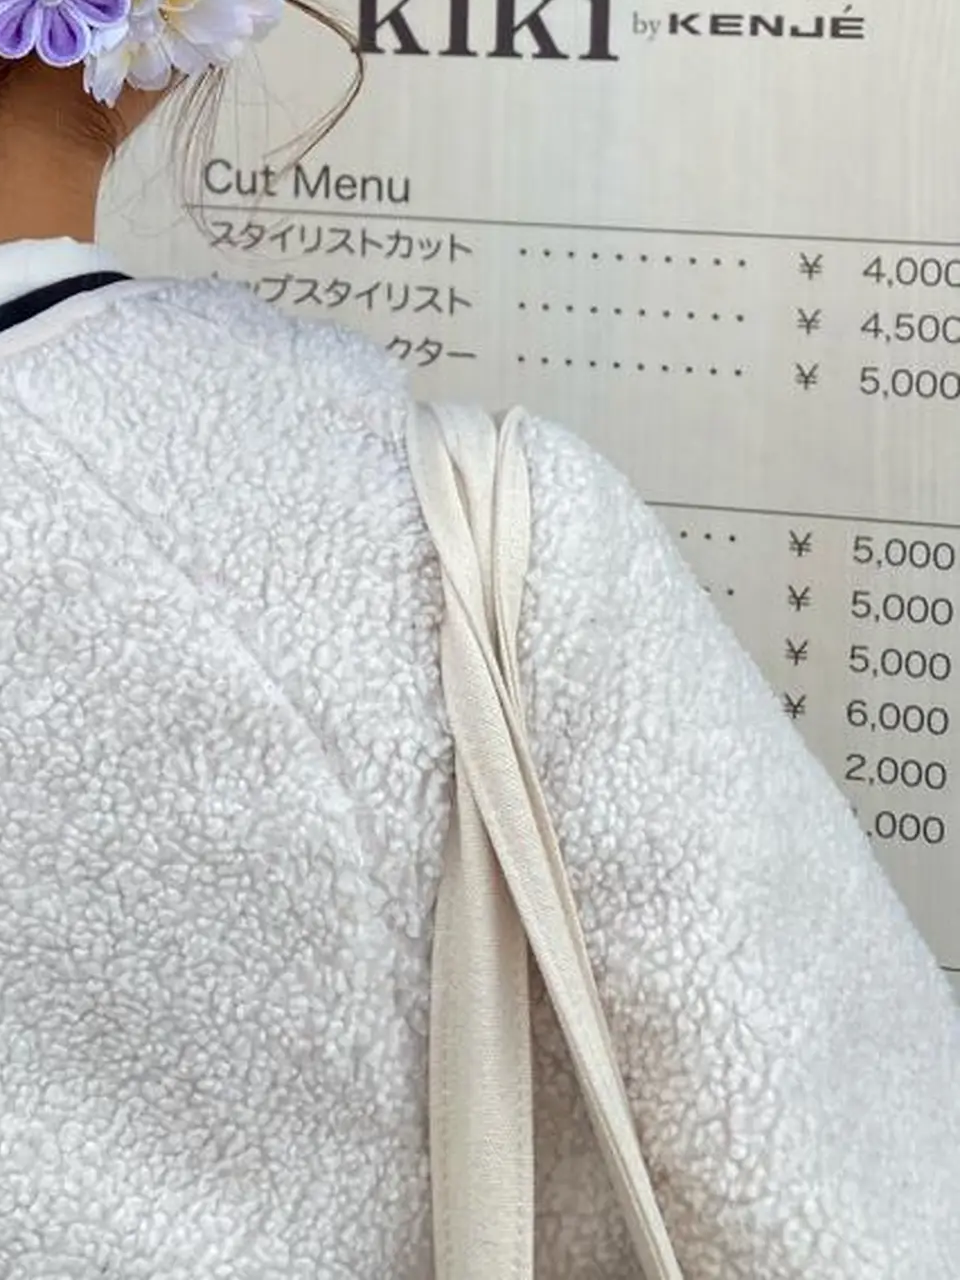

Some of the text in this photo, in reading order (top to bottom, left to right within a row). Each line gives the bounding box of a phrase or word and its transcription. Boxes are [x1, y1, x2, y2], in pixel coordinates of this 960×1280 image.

[632, 11, 662, 39] by
[668, 4, 864, 40] KENJÉ
[204, 158, 411, 204] Cut Menu
[209, 221, 473, 262] スタイリストカット
[210, 270, 473, 316] プスタイリスト
[860, 312, 960, 345] 4,500
[860, 366, 960, 400] 5,000
[852, 535, 955, 570] 5,000
[851, 590, 953, 625] 5,000
[849, 645, 951, 681] 5,000
[846, 699, 949, 735] 6,000
[844, 753, 947, 790] 2,000
[852, 806, 945, 844] ,000
